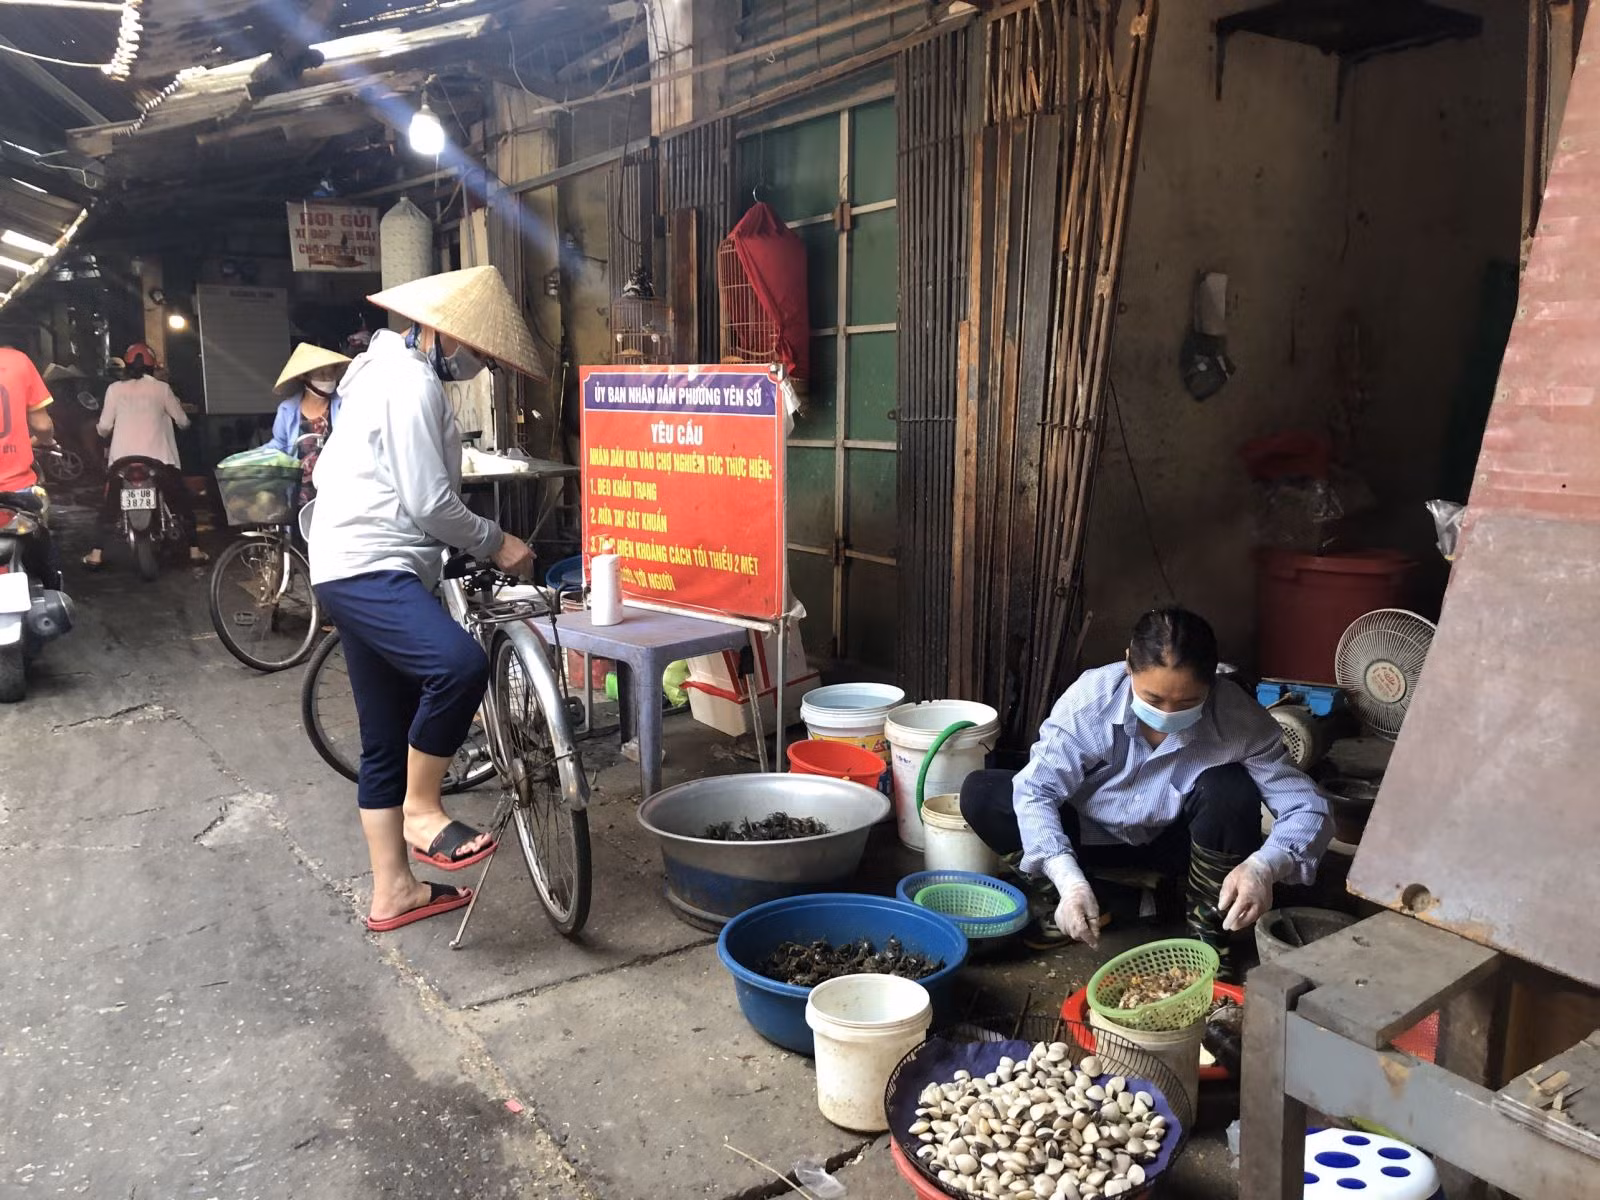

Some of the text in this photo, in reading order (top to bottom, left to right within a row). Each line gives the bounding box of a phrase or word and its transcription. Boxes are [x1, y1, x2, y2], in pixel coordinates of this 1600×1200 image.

[607, 386, 627, 403] BAN
[628, 383, 655, 404] NHÂN
[656, 383, 677, 404] DÂN
[678, 383, 721, 406] PHƯỜNG
[723, 384, 744, 406] YÊN
[746, 382, 762, 407] SỞ
[651, 419, 674, 444] YÊU
[625, 449, 638, 469] KHI
[639, 448, 655, 470] VÀO
[656, 451, 672, 476] CHỢ
[673, 451, 705, 474] NGHIÊM
[706, 451, 723, 475] TÚC
[725, 456, 747, 481] THỰC
[590, 477, 597, 495] 1.
[633, 481, 657, 501] TRANG
[590, 506, 597, 524] 2.
[613, 508, 625, 528] TAY
[626, 507, 640, 529] SÁT
[669, 544, 692, 566] CÁCH
[693, 543, 708, 568] TỐI
[734, 554, 739, 573] 2
[740, 553, 759, 576] MÉT
[647, 571, 676, 592] NGƯỜI
